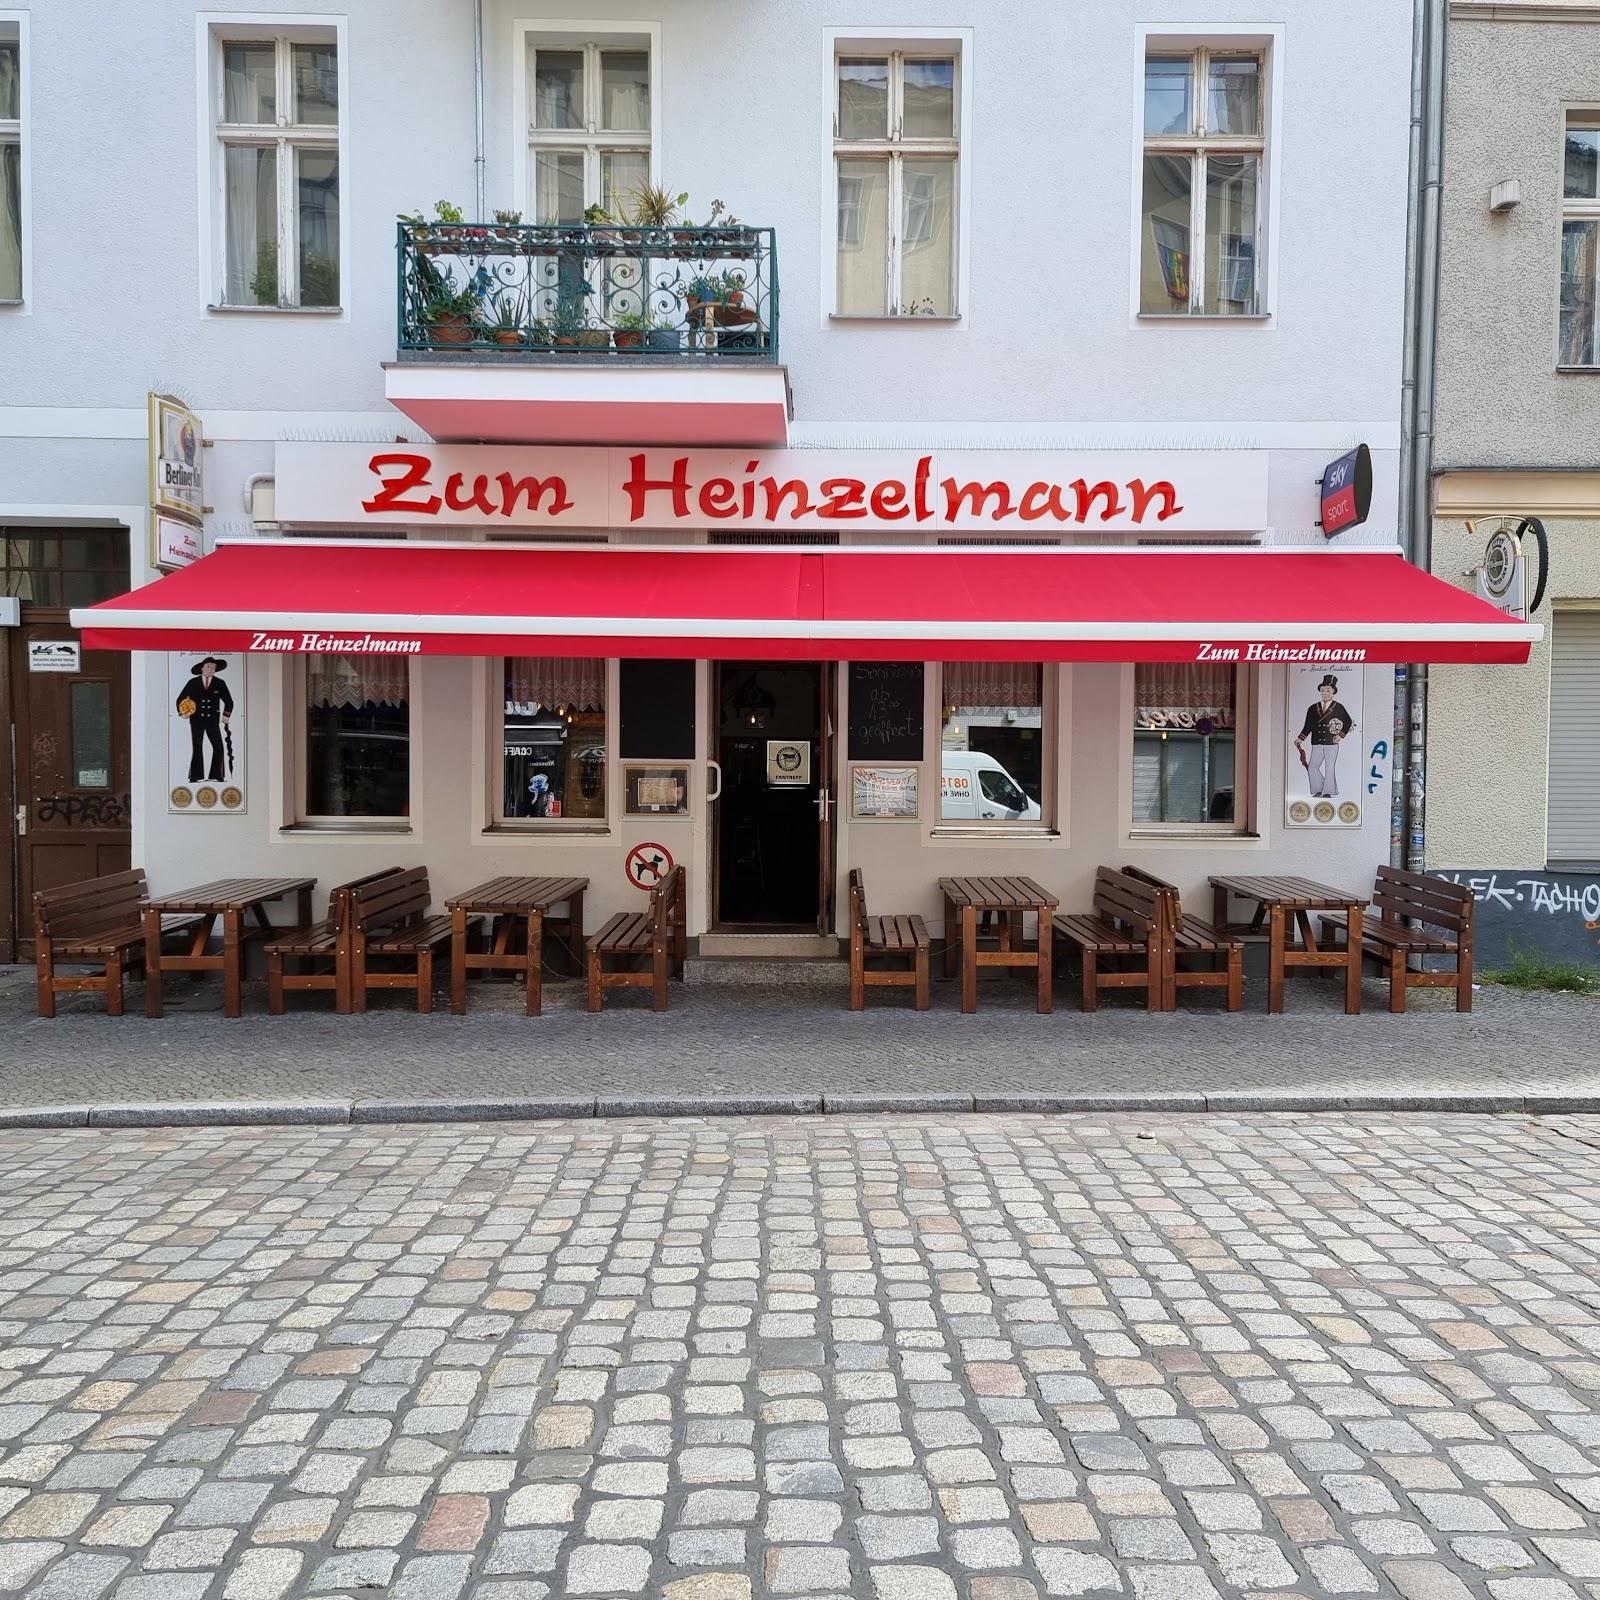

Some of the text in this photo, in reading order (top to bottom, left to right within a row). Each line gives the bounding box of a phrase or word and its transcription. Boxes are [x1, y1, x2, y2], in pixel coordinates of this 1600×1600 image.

[165, 463, 193, 486] Berliner
[1329, 463, 1349, 488] sky
[361, 453, 1185, 522] Zum Heinzelmann
[1328, 498, 1349, 522] sport
[183, 535, 197, 548] Zum
[250, 633, 422, 653] Zum Heinzelmann
[1196, 643, 1367, 661] Zum Heinzelmann
